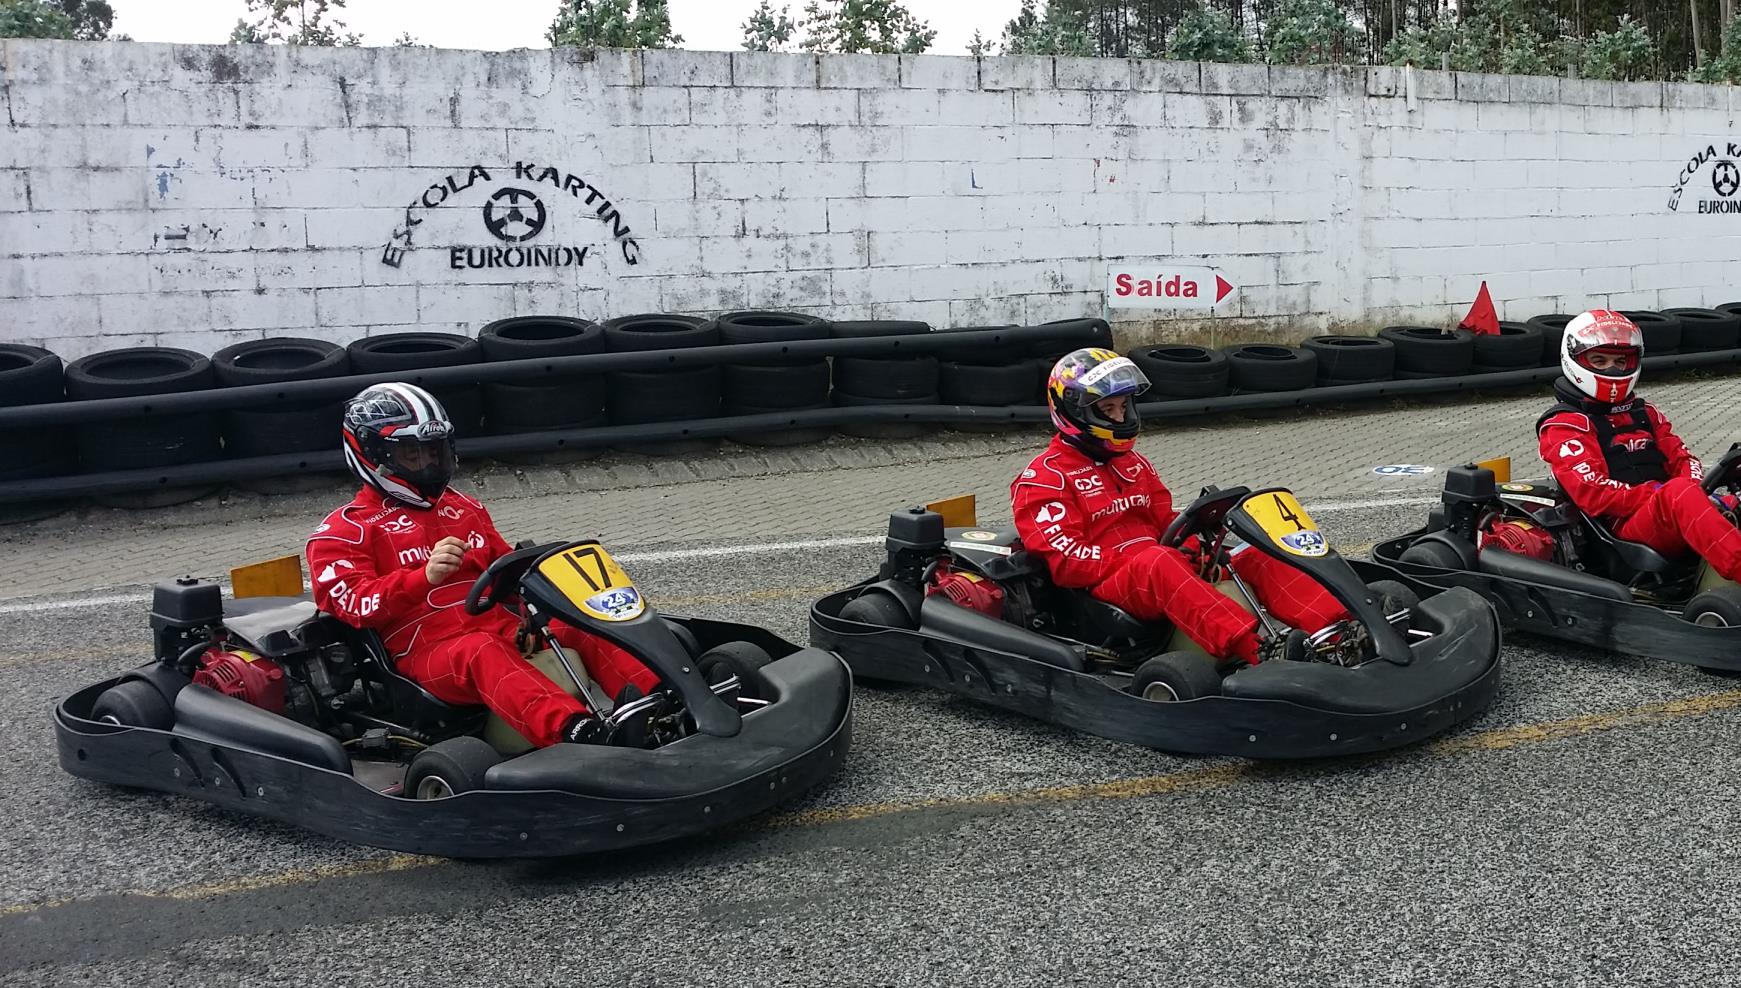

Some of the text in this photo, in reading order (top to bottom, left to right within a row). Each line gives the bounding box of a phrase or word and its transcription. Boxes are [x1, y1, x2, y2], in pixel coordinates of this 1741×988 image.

[1667, 144, 1717, 212] ESCOLA
[381, 160, 640, 270] ESCOLA KARTING
[449, 246, 589, 270] EUROINDY
[1115, 273, 1199, 298] Saída
[1272, 493, 1308, 531] 4
[561, 546, 613, 593] 17
